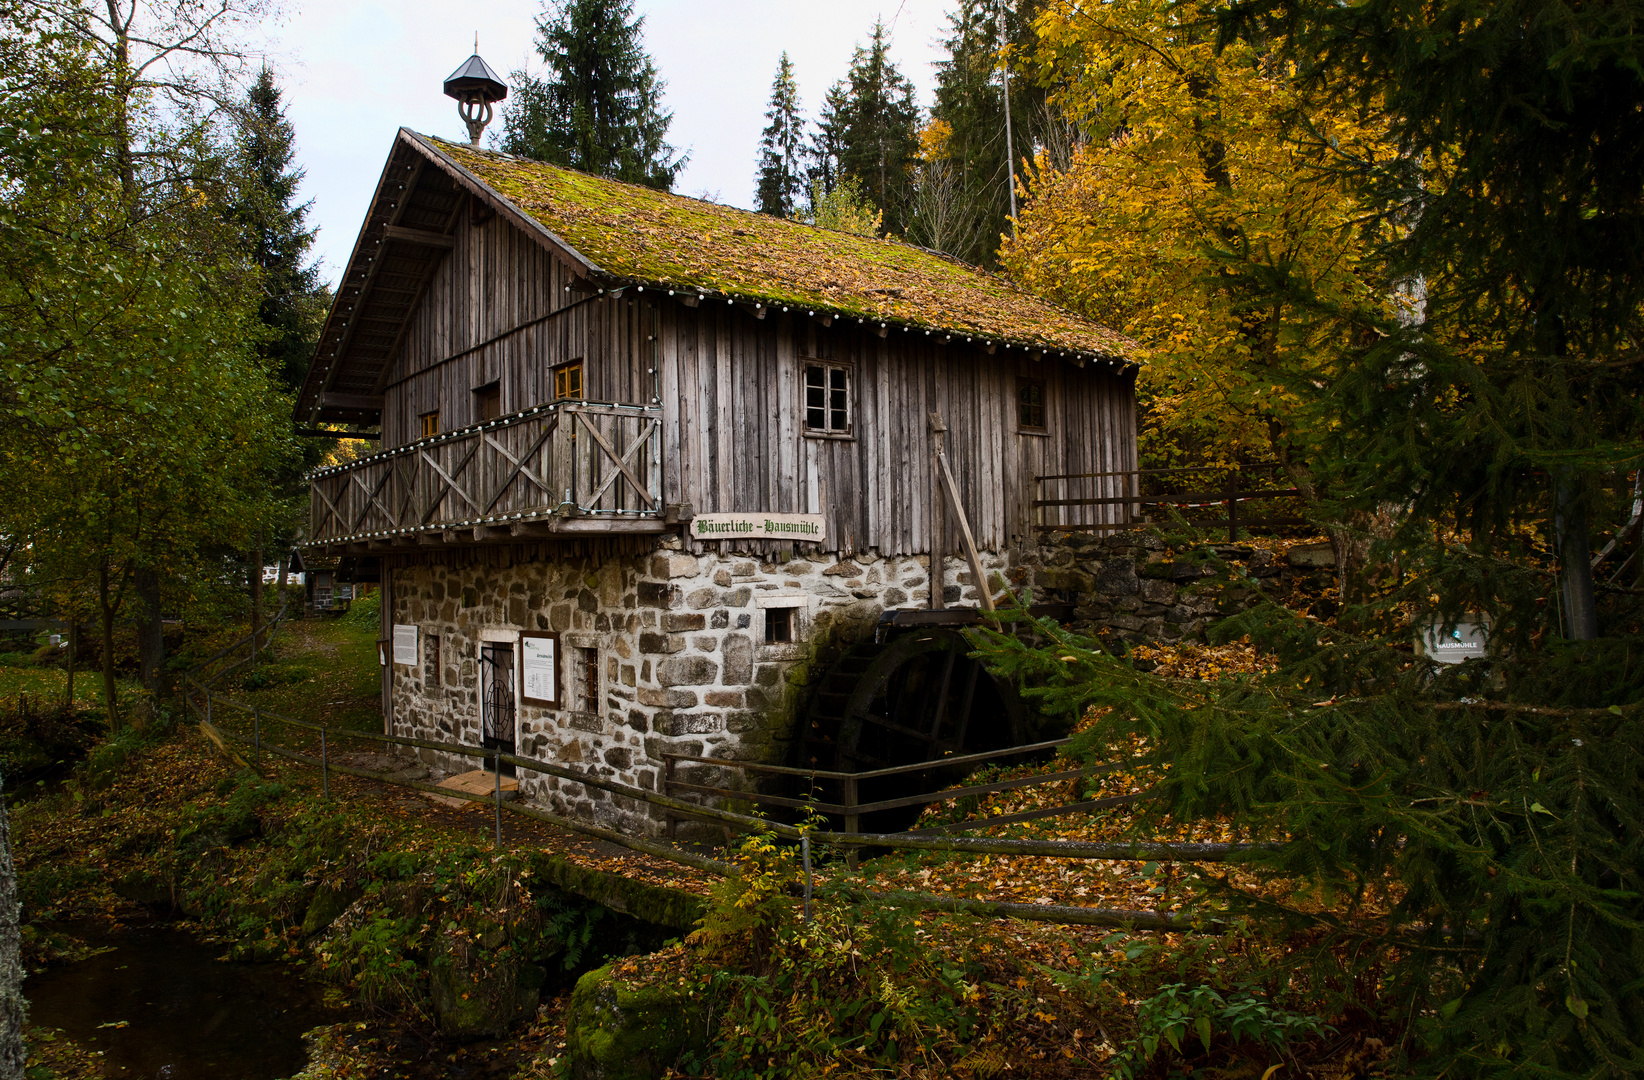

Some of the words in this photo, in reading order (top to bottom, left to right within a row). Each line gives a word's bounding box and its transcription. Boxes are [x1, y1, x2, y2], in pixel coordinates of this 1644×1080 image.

[697, 519, 753, 535] Bäuerliche
[764, 519, 819, 535] Hausmühle
[1454, 630, 1460, 638] 2
